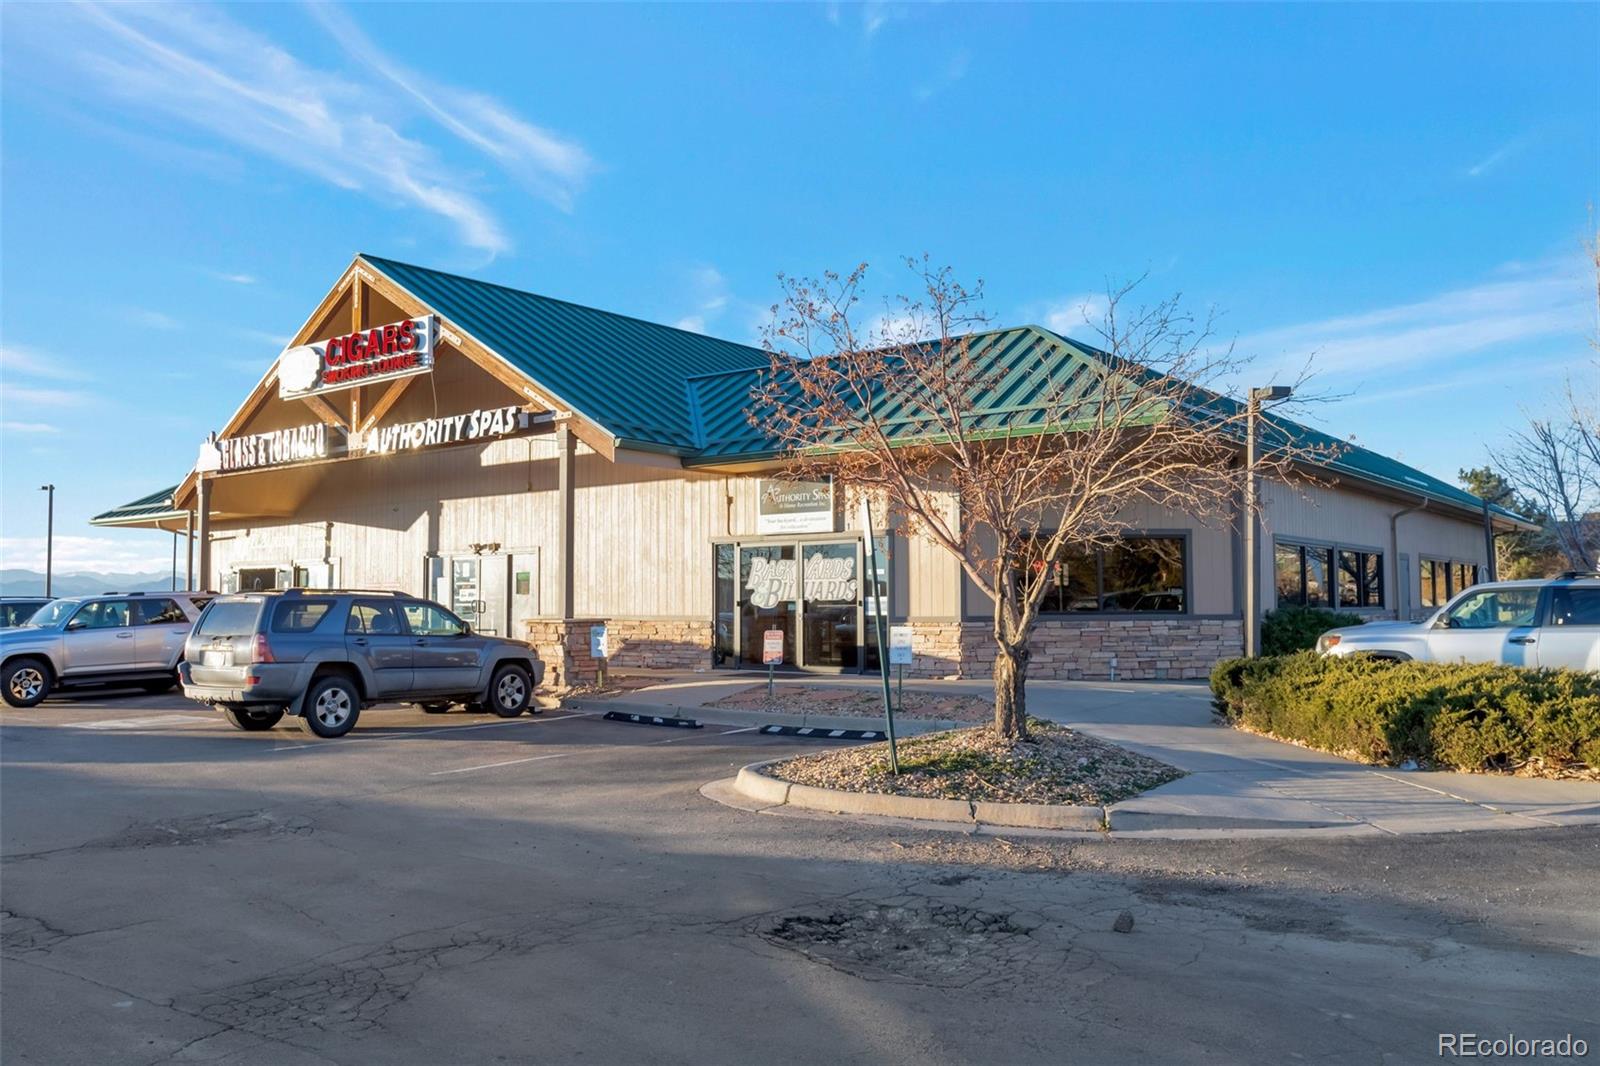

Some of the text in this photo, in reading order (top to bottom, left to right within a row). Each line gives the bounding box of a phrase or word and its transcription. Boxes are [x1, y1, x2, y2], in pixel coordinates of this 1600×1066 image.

[325, 320, 416, 367] CIGARS
[322, 353, 418, 384] SMOKING LOUNGE
[366, 406, 517, 455] AUTHORITY SPAS
[221, 435, 257, 470] GLASS
